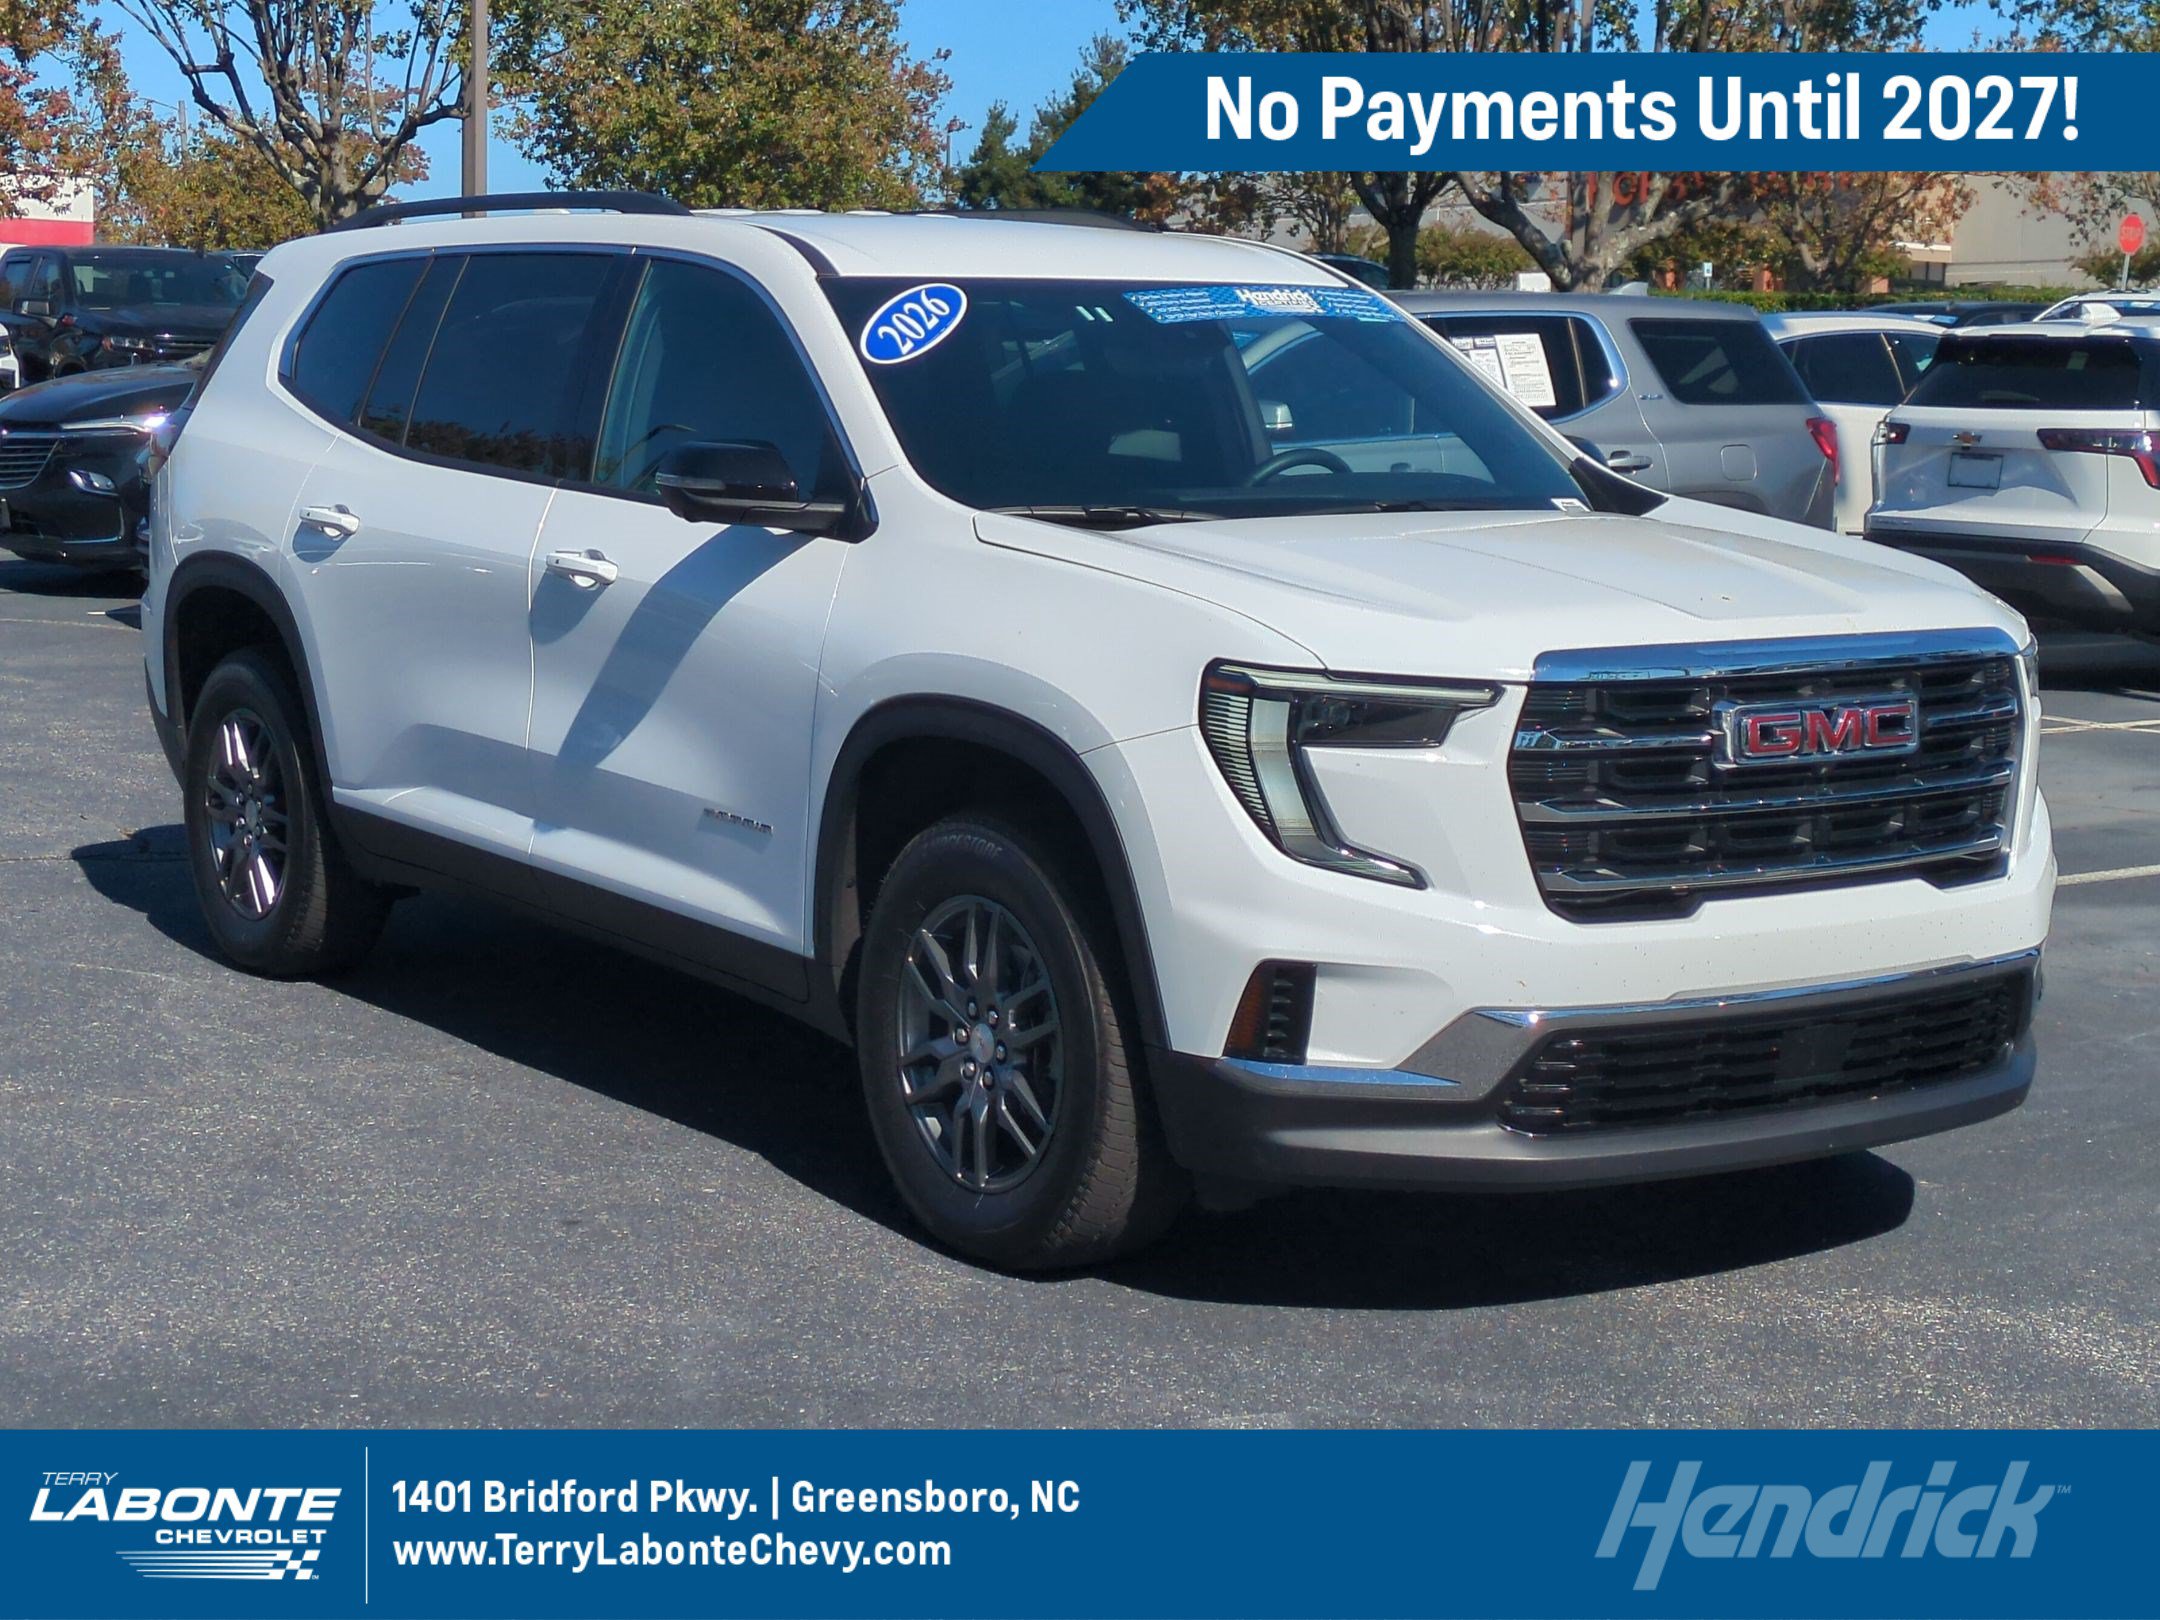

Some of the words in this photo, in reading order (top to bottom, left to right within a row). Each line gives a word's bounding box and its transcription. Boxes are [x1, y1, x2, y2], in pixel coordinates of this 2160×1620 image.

[877, 288, 950, 355] 2026
[1235, 289, 1315, 306] Hendrick
[1746, 703, 1913, 757] GMC
